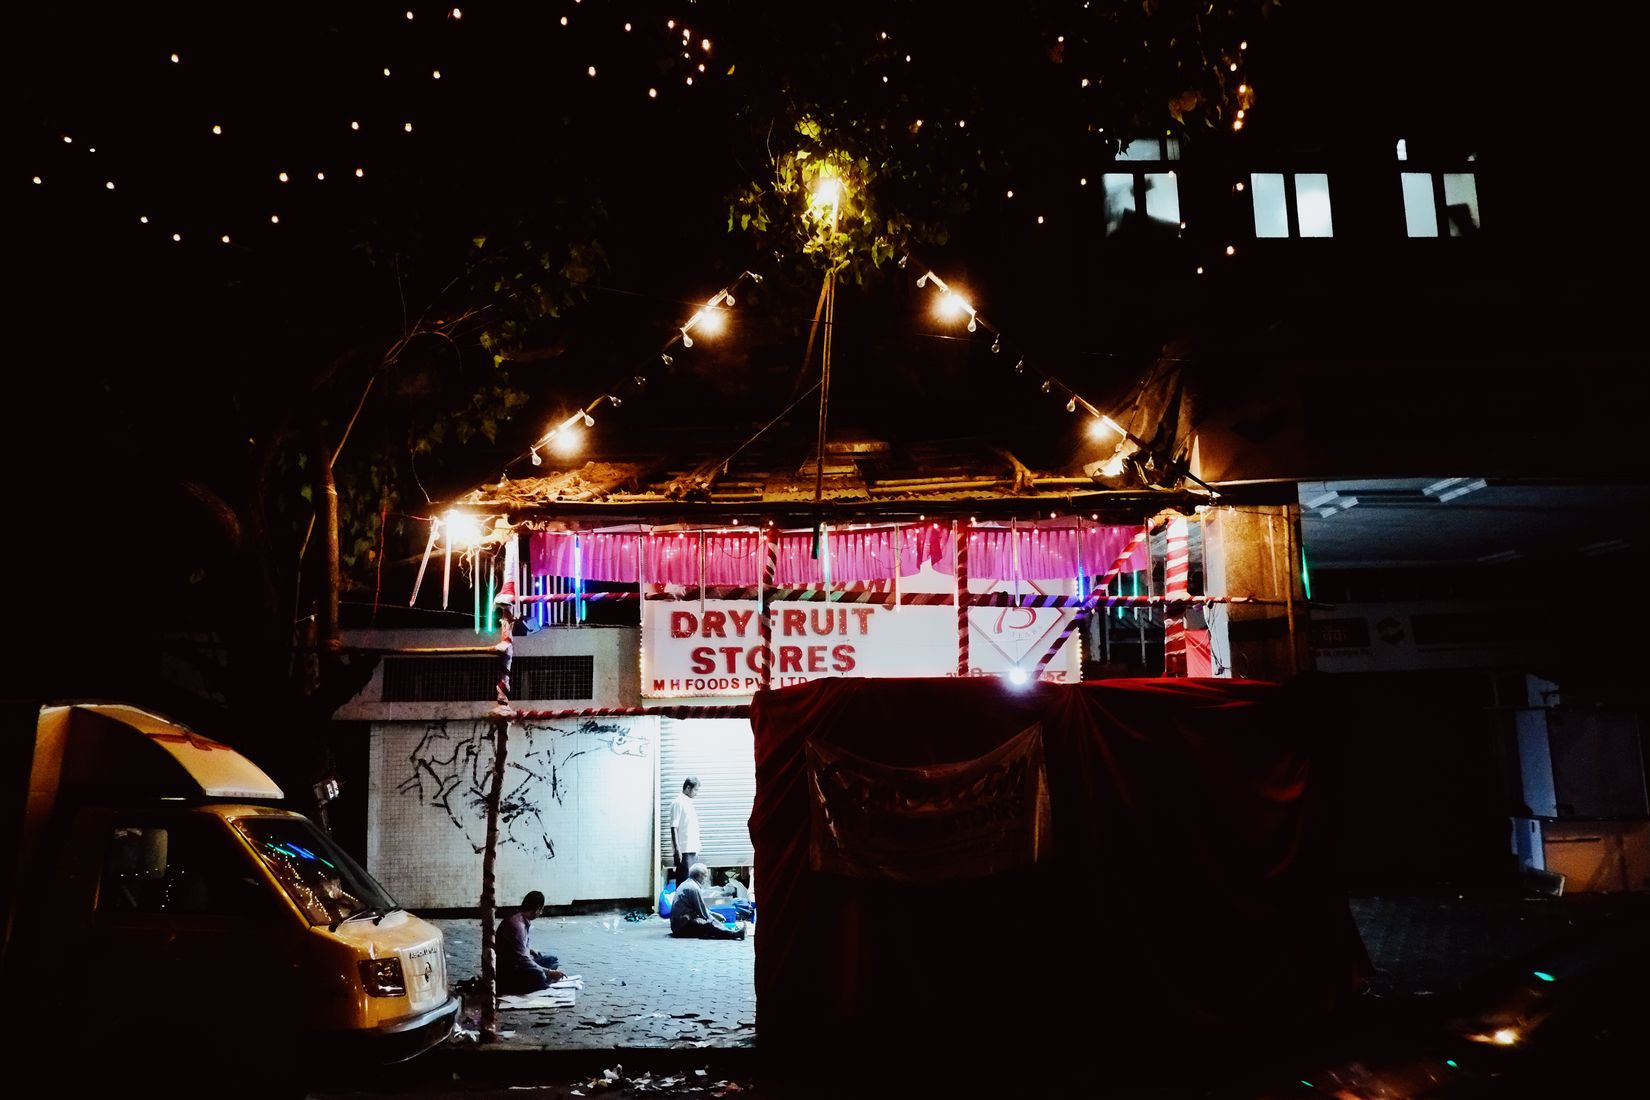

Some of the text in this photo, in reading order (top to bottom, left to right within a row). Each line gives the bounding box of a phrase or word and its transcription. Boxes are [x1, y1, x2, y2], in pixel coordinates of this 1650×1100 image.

[690, 645, 856, 675] STORES
[653, 679, 665, 691] M
[670, 679, 680, 691] H
[685, 677, 740, 691] FOODS
